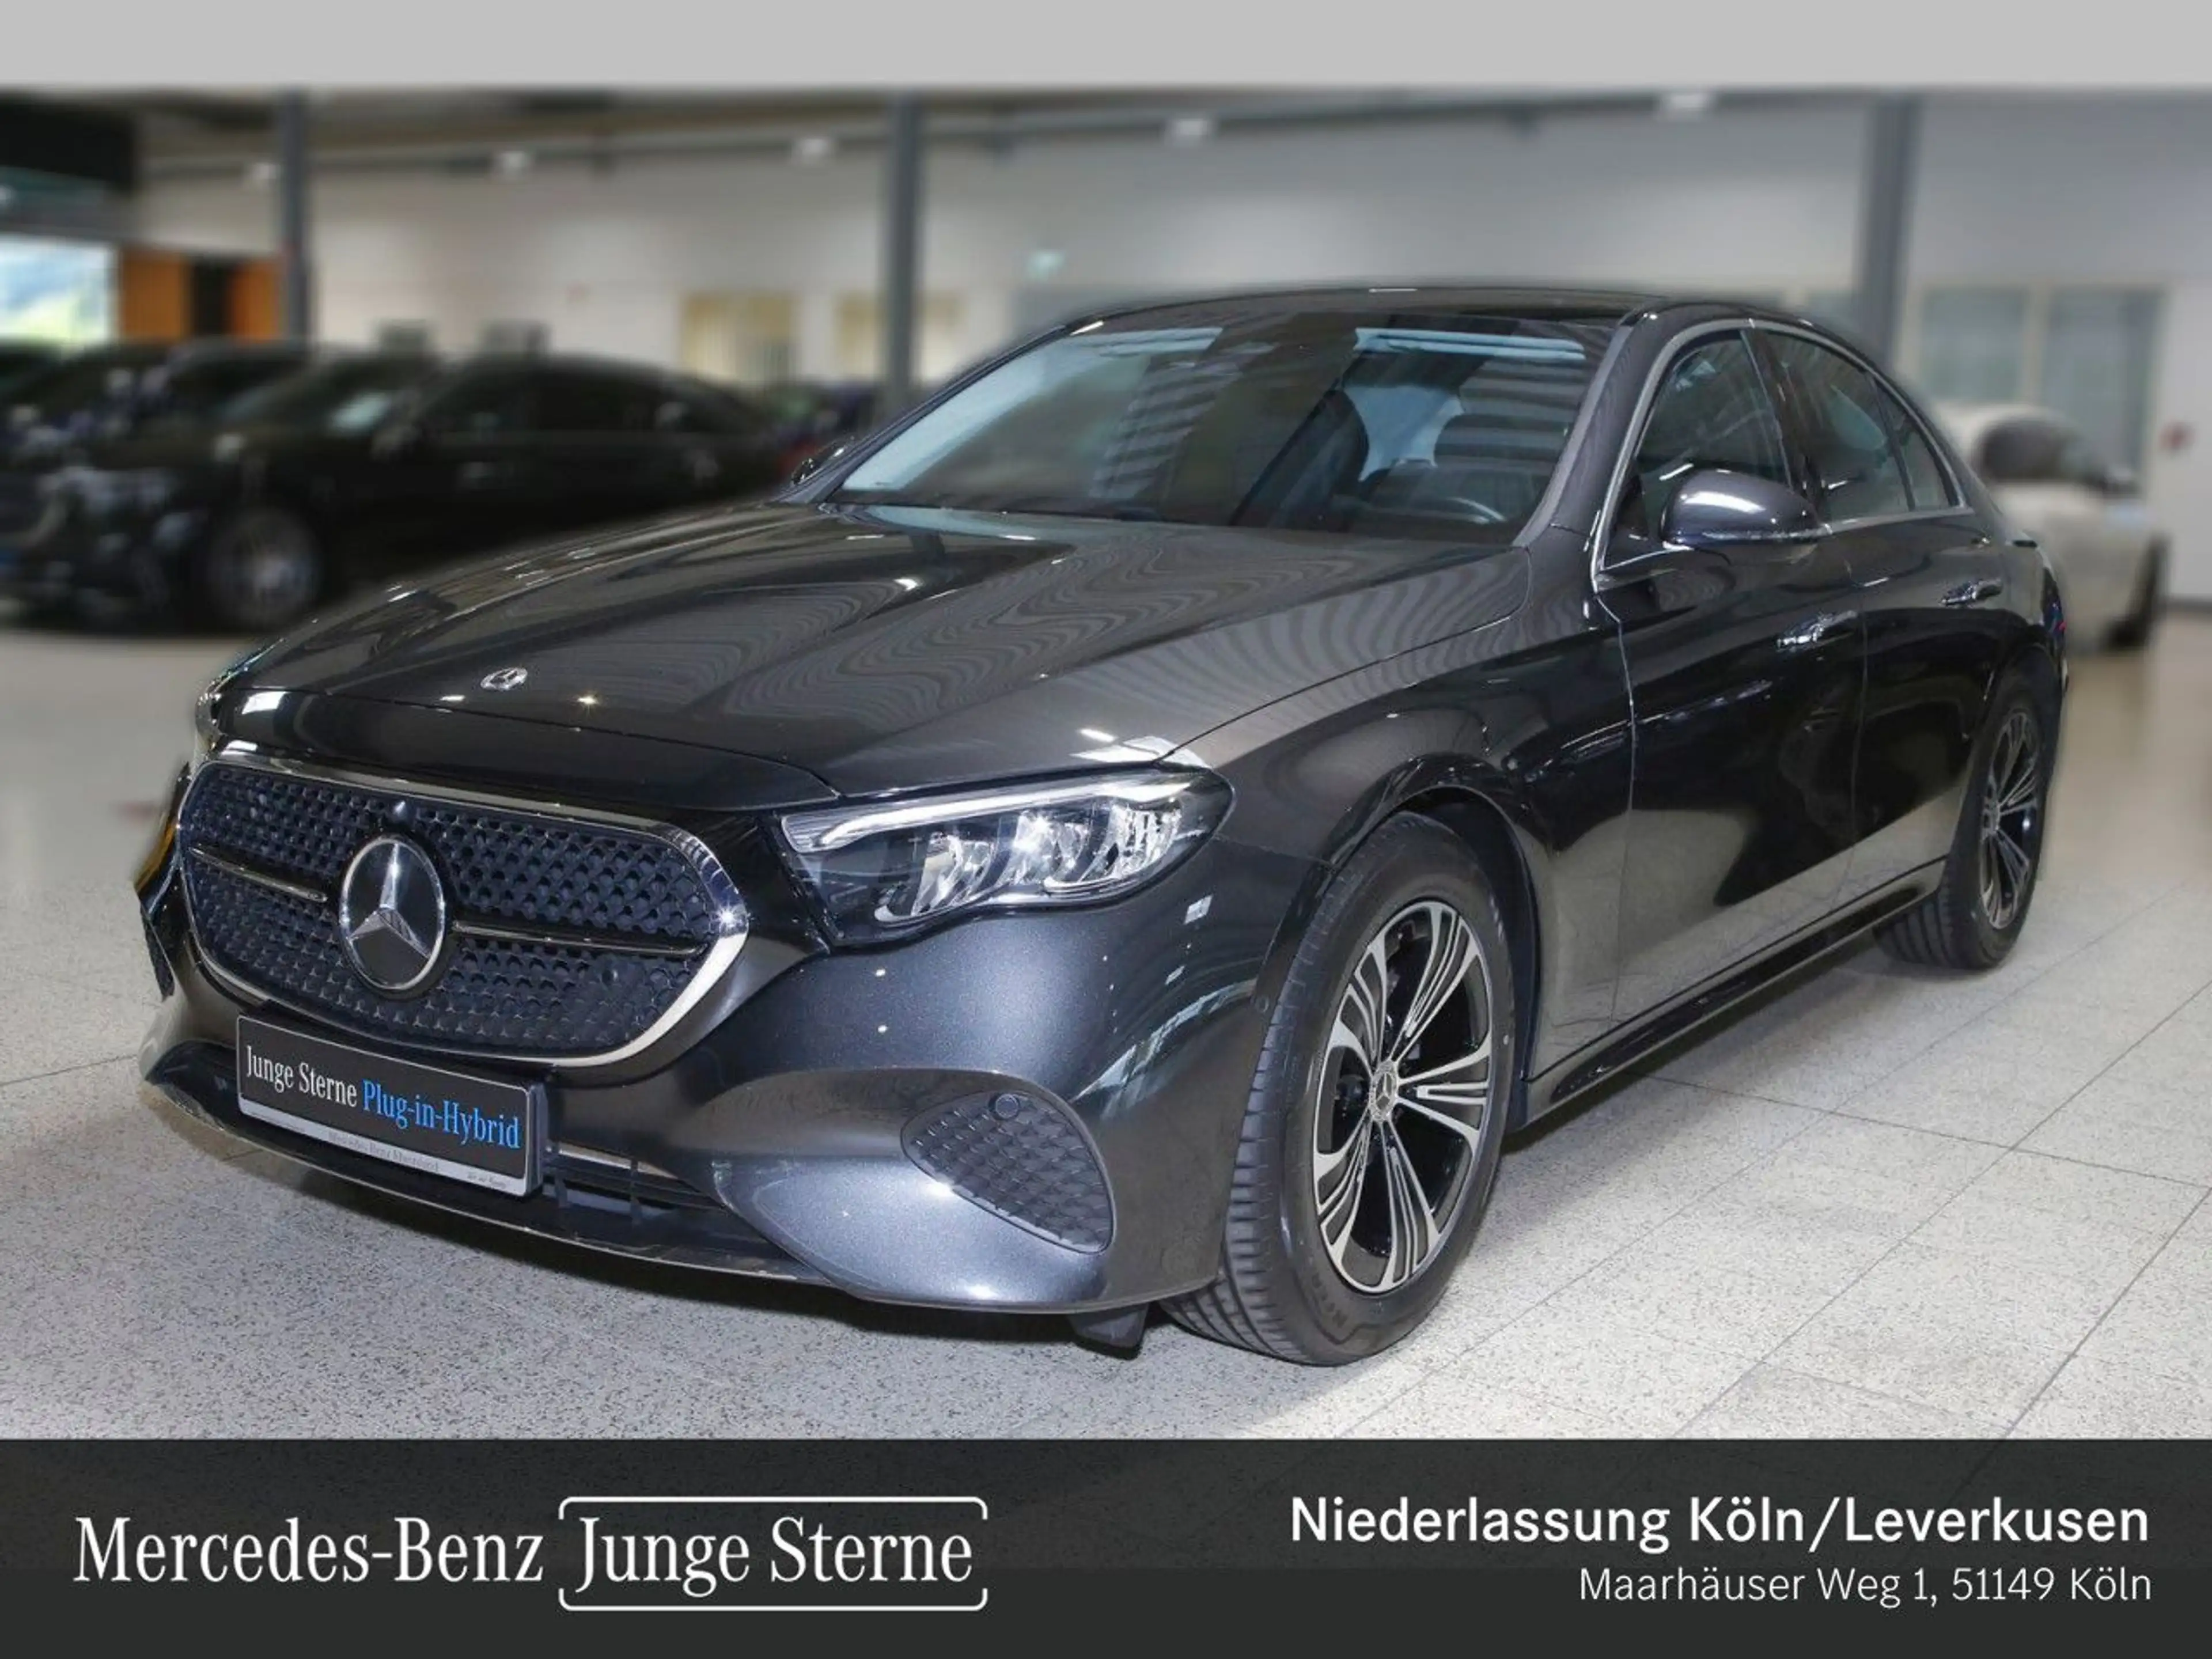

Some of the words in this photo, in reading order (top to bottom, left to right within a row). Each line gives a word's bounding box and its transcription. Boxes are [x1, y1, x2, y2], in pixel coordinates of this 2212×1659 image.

[246, 1046, 294, 1093] Junge
[298, 1062, 358, 1108] Sterne
[362, 1078, 520, 1149] Plug-in-Hybrid
